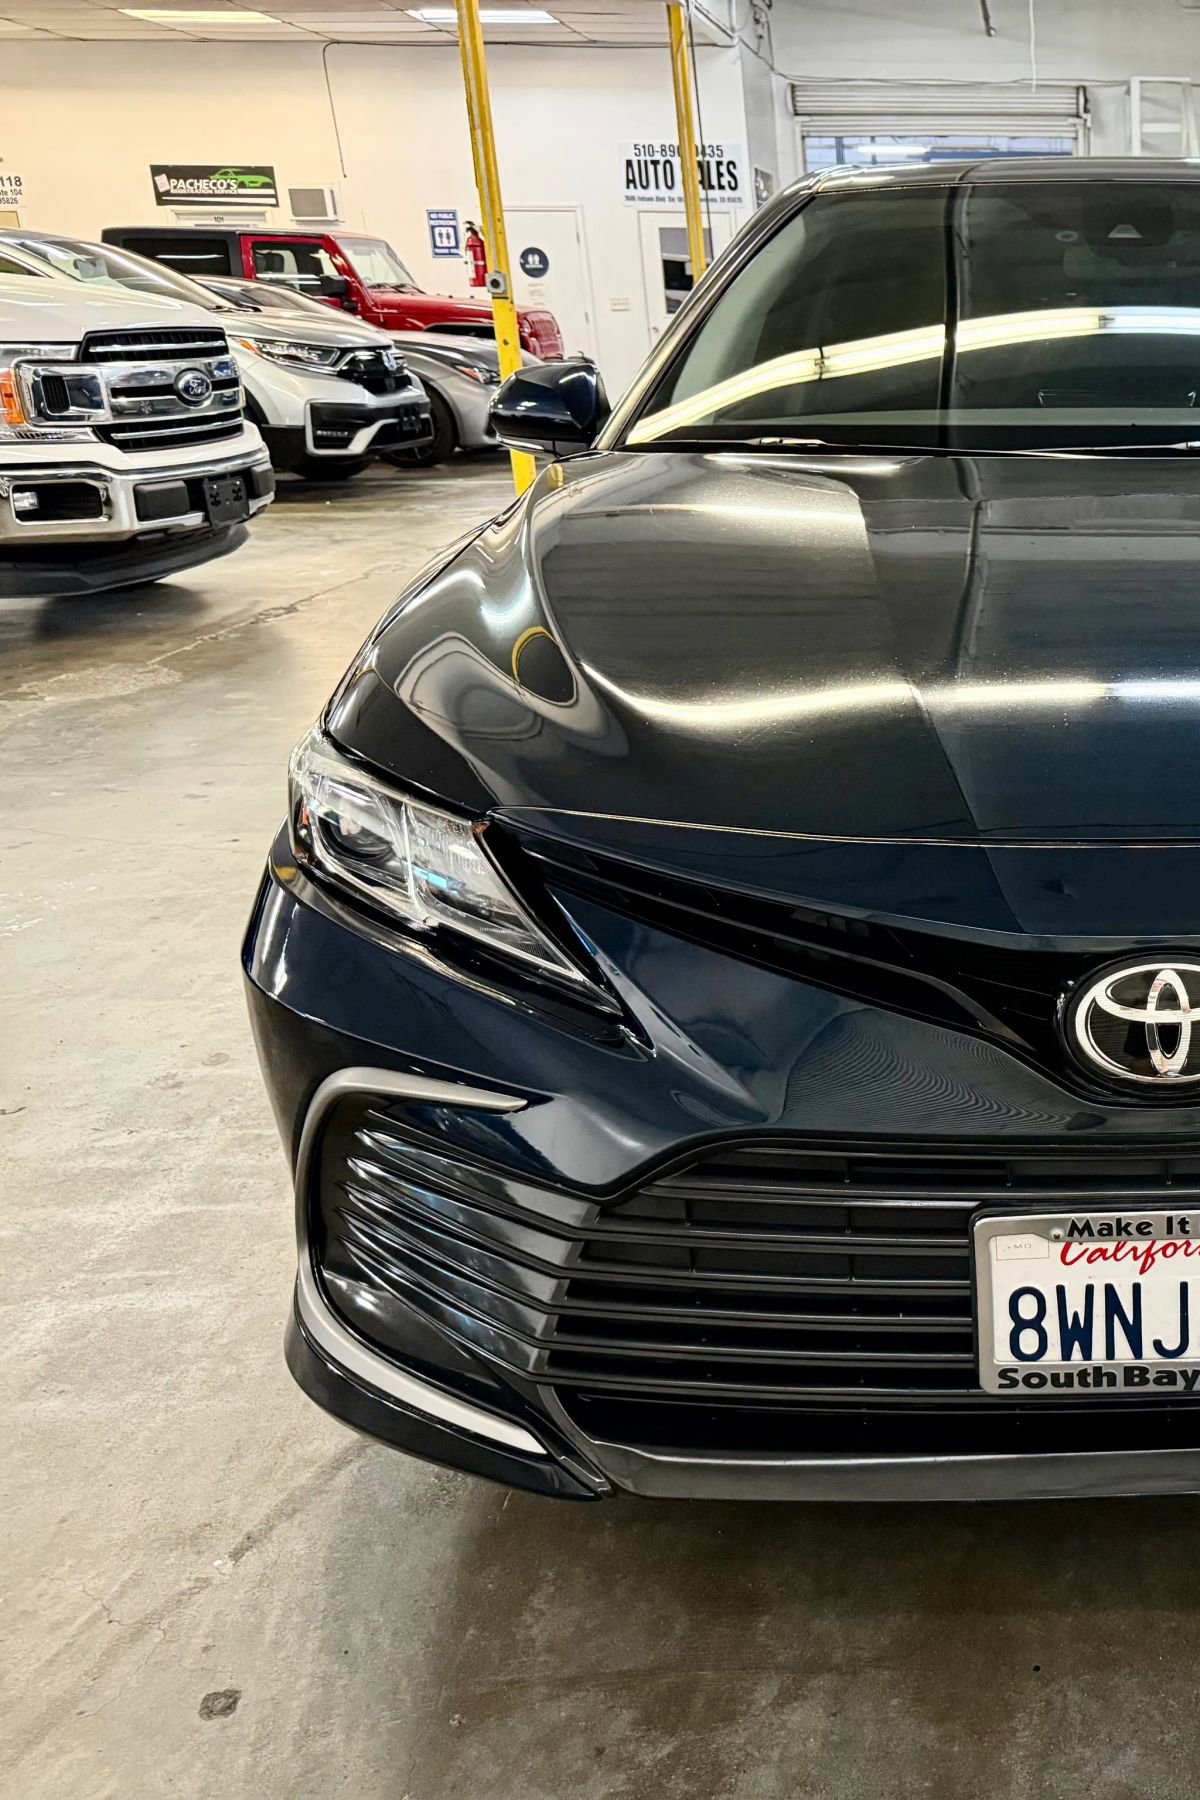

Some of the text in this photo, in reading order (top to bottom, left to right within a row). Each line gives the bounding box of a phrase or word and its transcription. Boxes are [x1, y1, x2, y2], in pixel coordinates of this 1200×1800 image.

[170, 178, 238, 190] PACHECO'S
[625, 159, 738, 191] AUTO ALES
[1068, 1217, 1153, 1238] Make
[1166, 1216, 1191, 1236] It
[997, 1365, 1117, 1389] South
